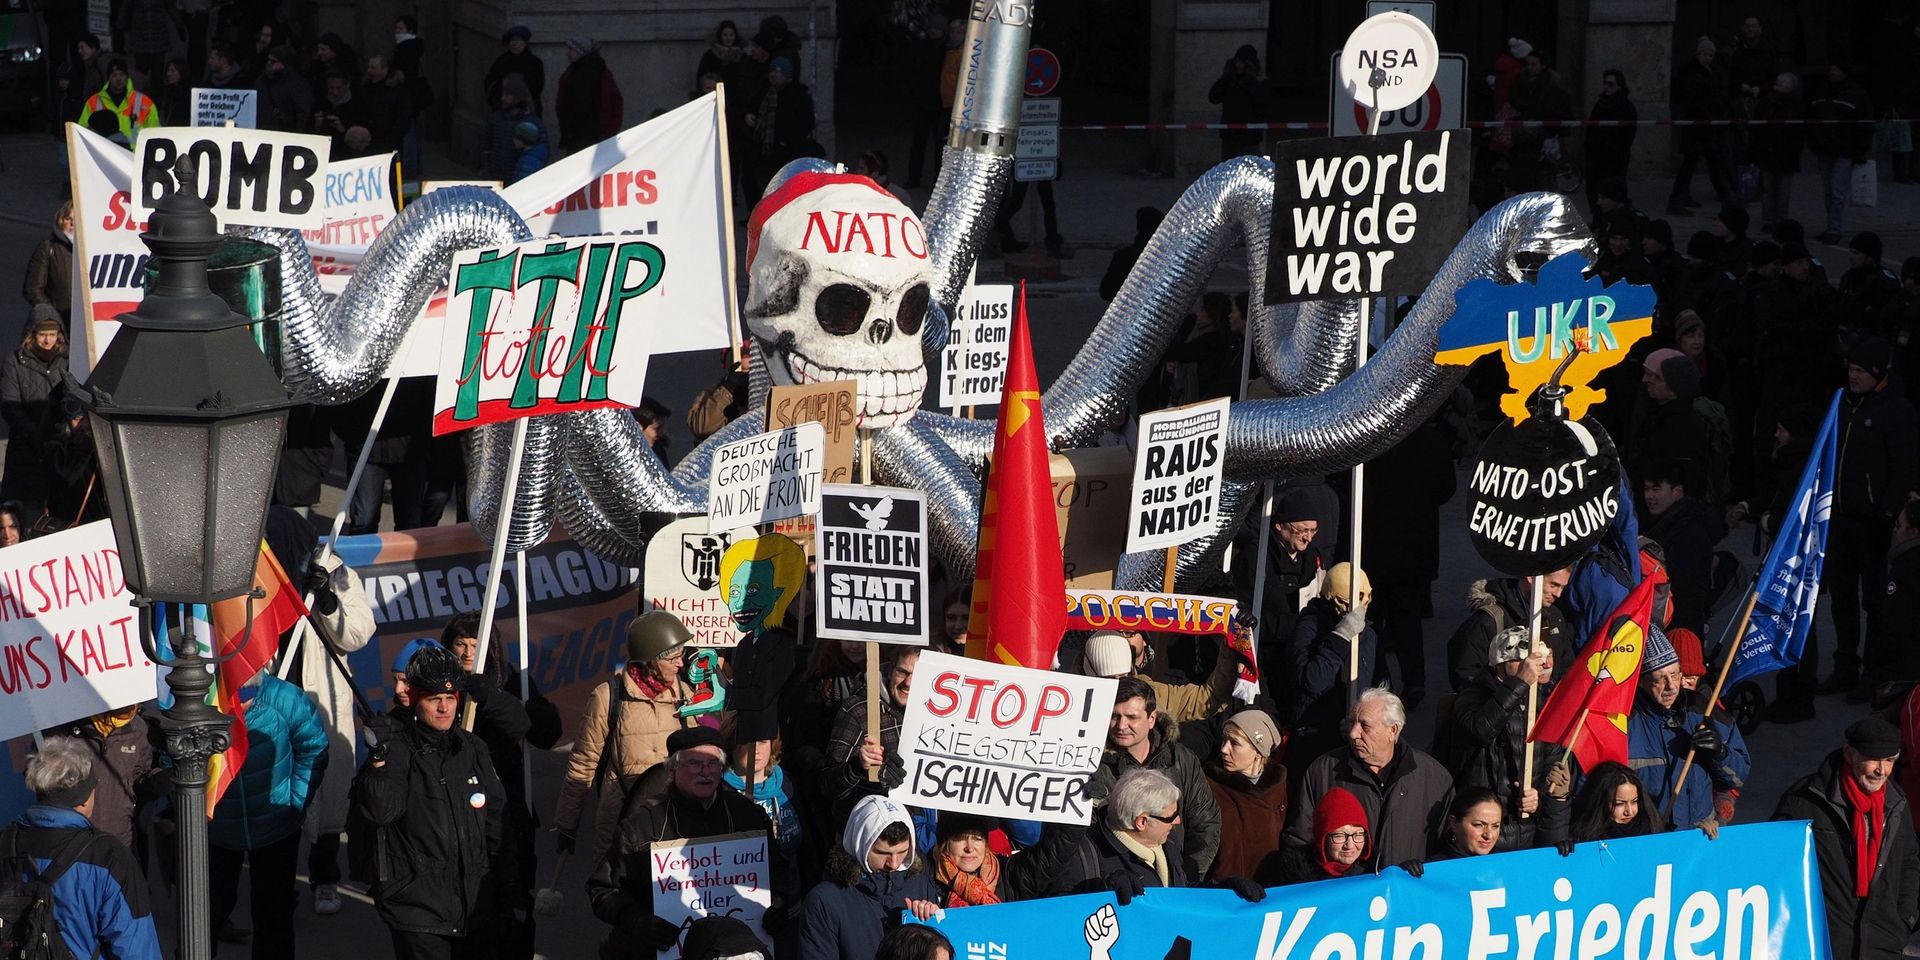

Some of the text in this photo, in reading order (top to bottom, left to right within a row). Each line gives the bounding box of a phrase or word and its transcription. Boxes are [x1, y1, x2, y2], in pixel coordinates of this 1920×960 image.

[1358, 48, 1418, 69] NSA
[198, 92, 240, 102] Für den Profit
[960, 38, 984, 133] CASSIDIAN
[1380, 75, 1403, 87] ND
[198, 102, 236, 110] der Reichen
[216, 111, 225, 119] sie
[1020, 128, 1053, 137] Einsatz-
[1030, 146, 1044, 154] frei
[1296, 130, 1450, 200] world
[142, 137, 320, 216] BOMB
[323, 166, 384, 208] RICAN
[798, 209, 930, 261] NATO
[1293, 195, 1417, 249] wide
[1287, 250, 1395, 296] war
[952, 299, 1008, 322] cluss
[452, 241, 667, 421] TTIP
[455, 295, 618, 387] tötet
[975, 323, 1007, 344] dem
[1507, 295, 1619, 364] UKR
[947, 348, 1007, 373] Kiegs-
[947, 371, 1004, 396] Trror!
[1150, 420, 1219, 442] AUFKÜNDIGEN
[1153, 412, 1219, 432] MORDALLIANZ
[720, 432, 800, 463] DEUTSCHE
[1144, 433, 1219, 481] RAUS
[1051, 479, 1108, 508] OP
[1141, 474, 1214, 506] aus der
[1470, 458, 1598, 500] NATO-OST-
[711, 491, 736, 520] AN
[739, 484, 761, 516] DIE
[765, 471, 821, 511] FRONT
[1138, 495, 1212, 538] NATO!
[1469, 485, 1618, 552] ERWEITERUNG
[823, 530, 921, 568] FRIEDEN
[0, 549, 126, 622] HLSTAND
[361, 549, 640, 625] KRIEGSTAGU
[830, 572, 915, 601] STATT
[652, 596, 720, 613] NICHT
[830, 598, 916, 625] NATO!
[690, 629, 737, 646] MEN
[0, 636, 52, 695] UNS
[924, 670, 1095, 738] STOP!
[911, 757, 1085, 819] ISCHINGER
[654, 848, 766, 875] Verbot und
[656, 870, 759, 895] Vernichtung
[689, 891, 736, 912] aller
[1255, 863, 1770, 960] Kein Frieden
